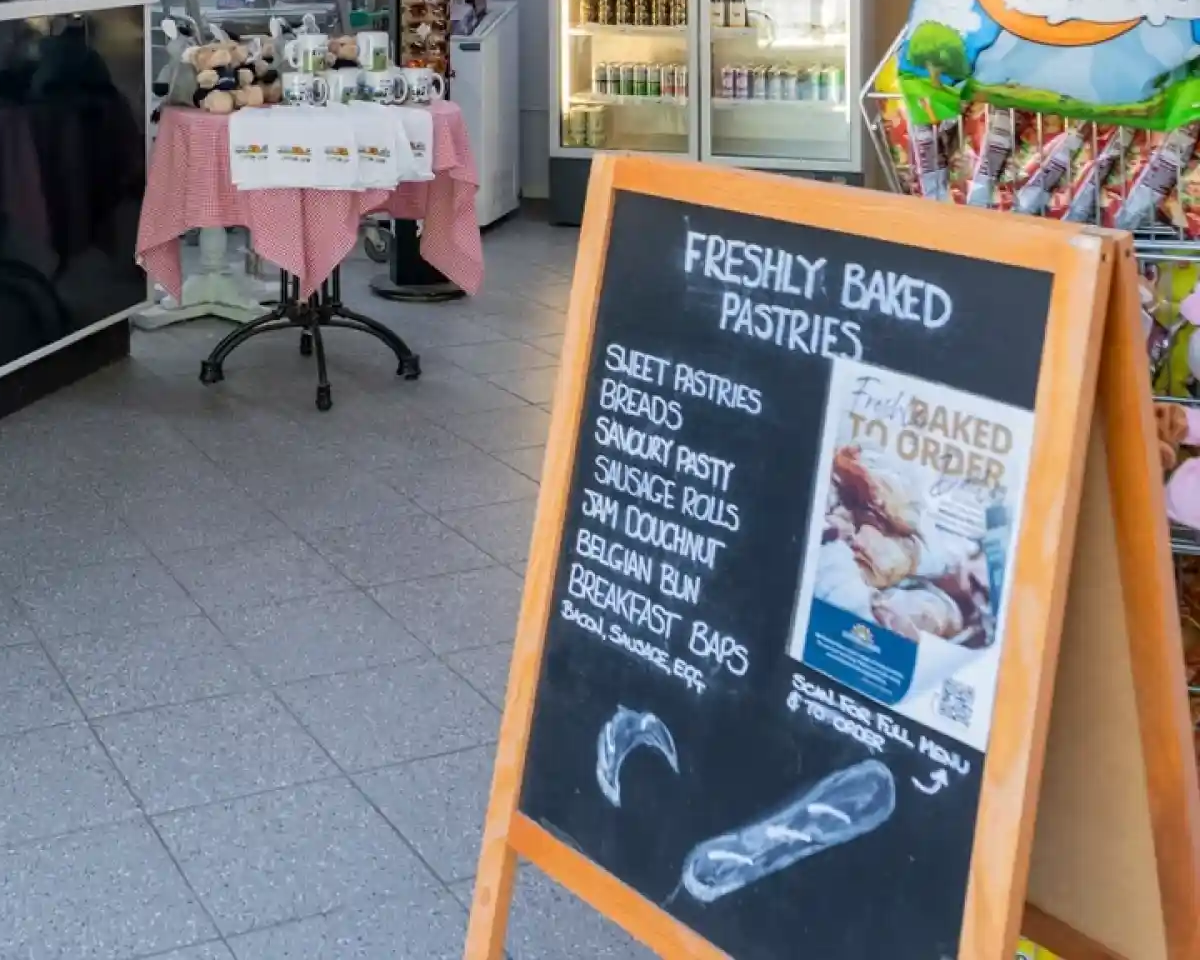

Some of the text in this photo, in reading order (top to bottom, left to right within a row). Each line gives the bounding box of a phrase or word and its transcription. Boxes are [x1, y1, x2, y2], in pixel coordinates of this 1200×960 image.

[683, 230, 953, 329] FRESHLY BAKED
[719, 292, 864, 362] PASTRIES
[599, 379, 682, 431] BREADS
[604, 343, 763, 416] SWEET PASTRIES
[594, 417, 735, 492] SAVOURY PASTY
[849, 410, 888, 448] TO
[896, 428, 1006, 488] ORDER
[909, 396, 1013, 455] BAKED
[581, 488, 619, 527] JAM
[593, 454, 741, 532] SAUSAGE ROLLS
[575, 528, 701, 604] BELGIAN BUN
[568, 562, 682, 639] BREAKFAST
[689, 621, 750, 678] BAPS
[803, 698, 825, 721] TO
[877, 712, 915, 749] FULL
[919, 735, 971, 776] MENU
